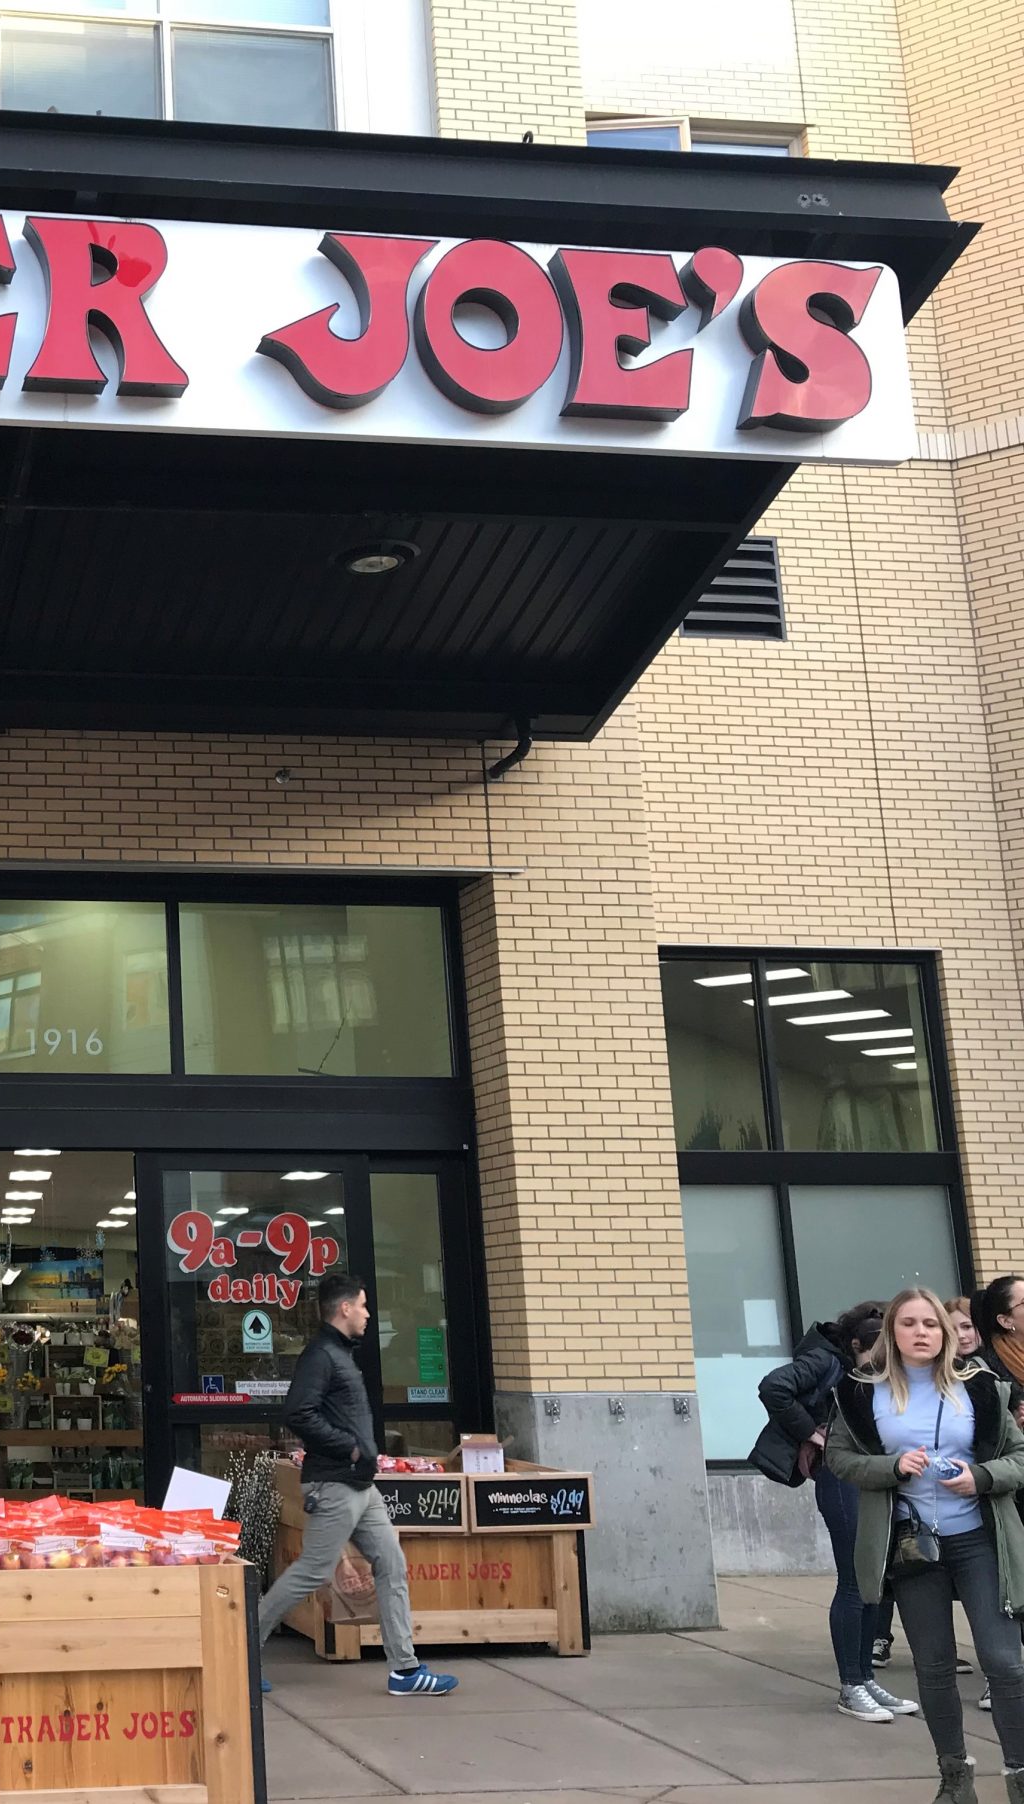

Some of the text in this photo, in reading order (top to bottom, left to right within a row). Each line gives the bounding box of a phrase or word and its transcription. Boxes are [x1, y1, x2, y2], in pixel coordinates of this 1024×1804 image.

[255, 232, 884, 431] JOE'S
[25, 1028, 103, 1056] 1916
[167, 1210, 339, 1275] 9a-9p
[207, 1273, 302, 1311] daily
[417, 1487, 460, 1518] $2.49
[487, 1488, 548, 1504] minneolas
[550, 1488, 584, 1515] $2.99
[406, 1562, 513, 1581] RADER JOES
[1, 1710, 196, 1744] TRADER JOES
